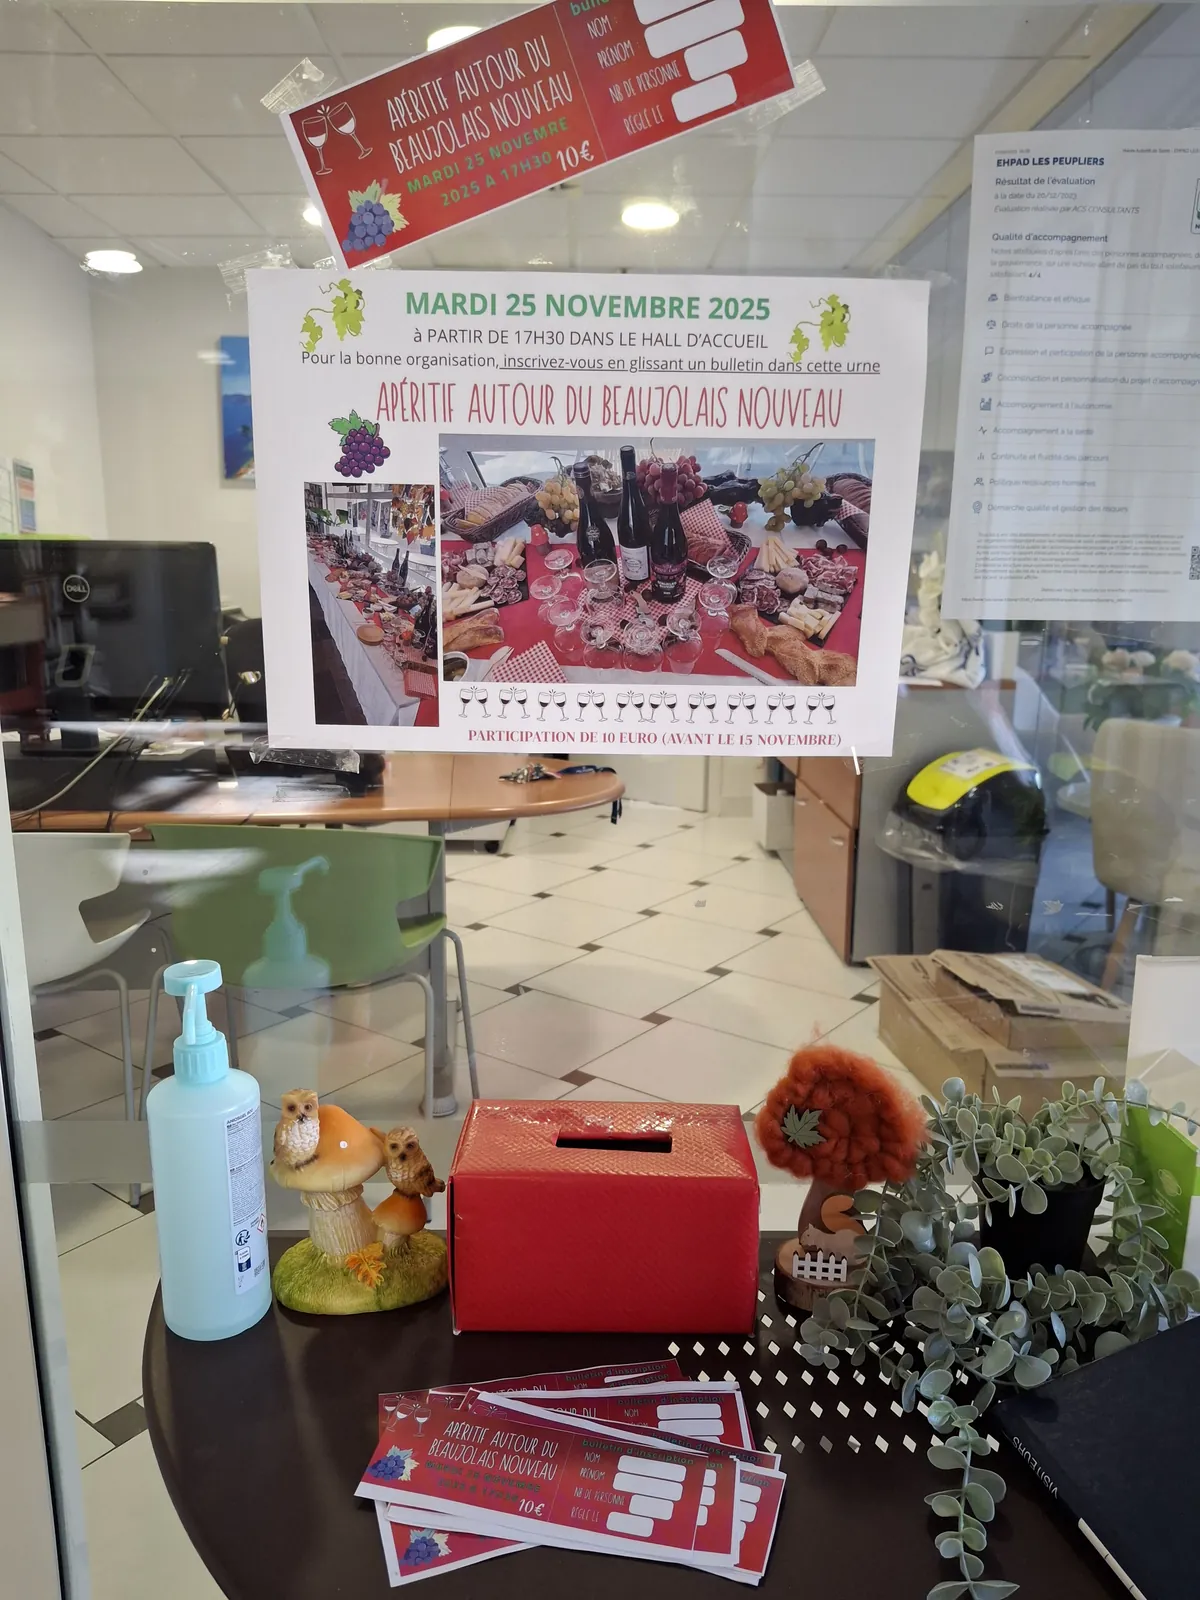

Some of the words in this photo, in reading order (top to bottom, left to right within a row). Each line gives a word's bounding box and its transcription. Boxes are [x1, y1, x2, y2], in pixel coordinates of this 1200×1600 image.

[587, 15, 612, 39] NOM
[596, 40, 635, 69] PRÉNOM
[387, 77, 449, 131] APÉRITIF
[455, 47, 525, 103] AUTOUR
[524, 35, 550, 72] DU
[609, 85, 623, 104] NB
[623, 82, 636, 96] DE
[637, 60, 682, 90] PERSONNE
[389, 106, 490, 174] BEAUJOLAIS
[489, 71, 573, 131] NOUVEAU
[650, 105, 664, 126] LE
[407, 162, 460, 194] MARDI
[465, 155, 485, 171] 25
[489, 117, 569, 160] NOVEMRE
[556, 140, 594, 172] 10€
[996, 157, 1030, 167] EHPAD
[1032, 157, 1050, 166] LES
[1052, 156, 1105, 166] PEUPLIERS
[440, 181, 481, 206] 2025
[501, 151, 552, 181] 17H30
[995, 177, 1031, 186] Résultat
[1033, 177, 1045, 185] de
[1047, 176, 1096, 186] l'évaluation
[992, 233, 1023, 242] Qualité
[1025, 233, 1108, 244] d'accompagnement
[406, 291, 497, 316] MARDI
[505, 293, 536, 316] 25
[545, 293, 700, 320] NOVEMBRE
[708, 296, 771, 320] 2025
[413, 328, 422, 343] à
[428, 328, 483, 343] PARTIR
[488, 329, 509, 344] DE
[515, 330, 565, 345] 17H30
[569, 331, 614, 346] DANS
[619, 332, 636, 346] LE
[642, 332, 682, 347] HALL
[687, 333, 768, 349] D'ACCUEIL
[302, 351, 335, 365] Pour
[339, 351, 352, 365] la
[356, 352, 402, 366] bonne
[406, 353, 500, 370] organisation,
[503, 353, 603, 369] inscrivez-vous
[607, 359, 625, 370] en
[629, 356, 683, 373] glissant
[688, 360, 706, 371] un
[710, 357, 764, 372] bulletin
[768, 358, 802, 372] dans
[806, 360, 842, 373] cette
[846, 361, 881, 373] urne
[376, 377, 456, 422] APÉRITIF
[467, 383, 555, 426] AUTOUR
[566, 385, 592, 425] DU
[602, 385, 728, 428] BEAUJOLAIS
[738, 387, 842, 429] NOUVEAU
[66, 584, 87, 593] DELL
[468, 729, 575, 744] PARTICIPATION
[579, 730, 598, 743] DE
[602, 731, 615, 744] 10
[619, 731, 658, 744] EURO
[661, 731, 714, 747] (AVANT
[717, 732, 735, 745] LE
[739, 733, 753, 746] 15
[757, 733, 842, 748] NOVEMBRE)
[565, 1371, 603, 1382] bulletin
[606, 1364, 667, 1376] d'inscription
[624, 1409, 639, 1418] NOM
[443, 1420, 490, 1444] APÉRITIF
[491, 1430, 538, 1455] AUTOUR
[541, 1442, 559, 1459] DU
[428, 1438, 499, 1469] BEAUJOLAIS
[499, 1454, 558, 1481] NOUVEAU
[582, 1439, 623, 1453] bulletin
[626, 1447, 694, 1465] d'inscription
[584, 1451, 600, 1463] NOM
[579, 1467, 606, 1480] PRÉNOM
[1012, 1436, 1059, 1500] VISITEURS
[518, 1498, 545, 1517] 10€
